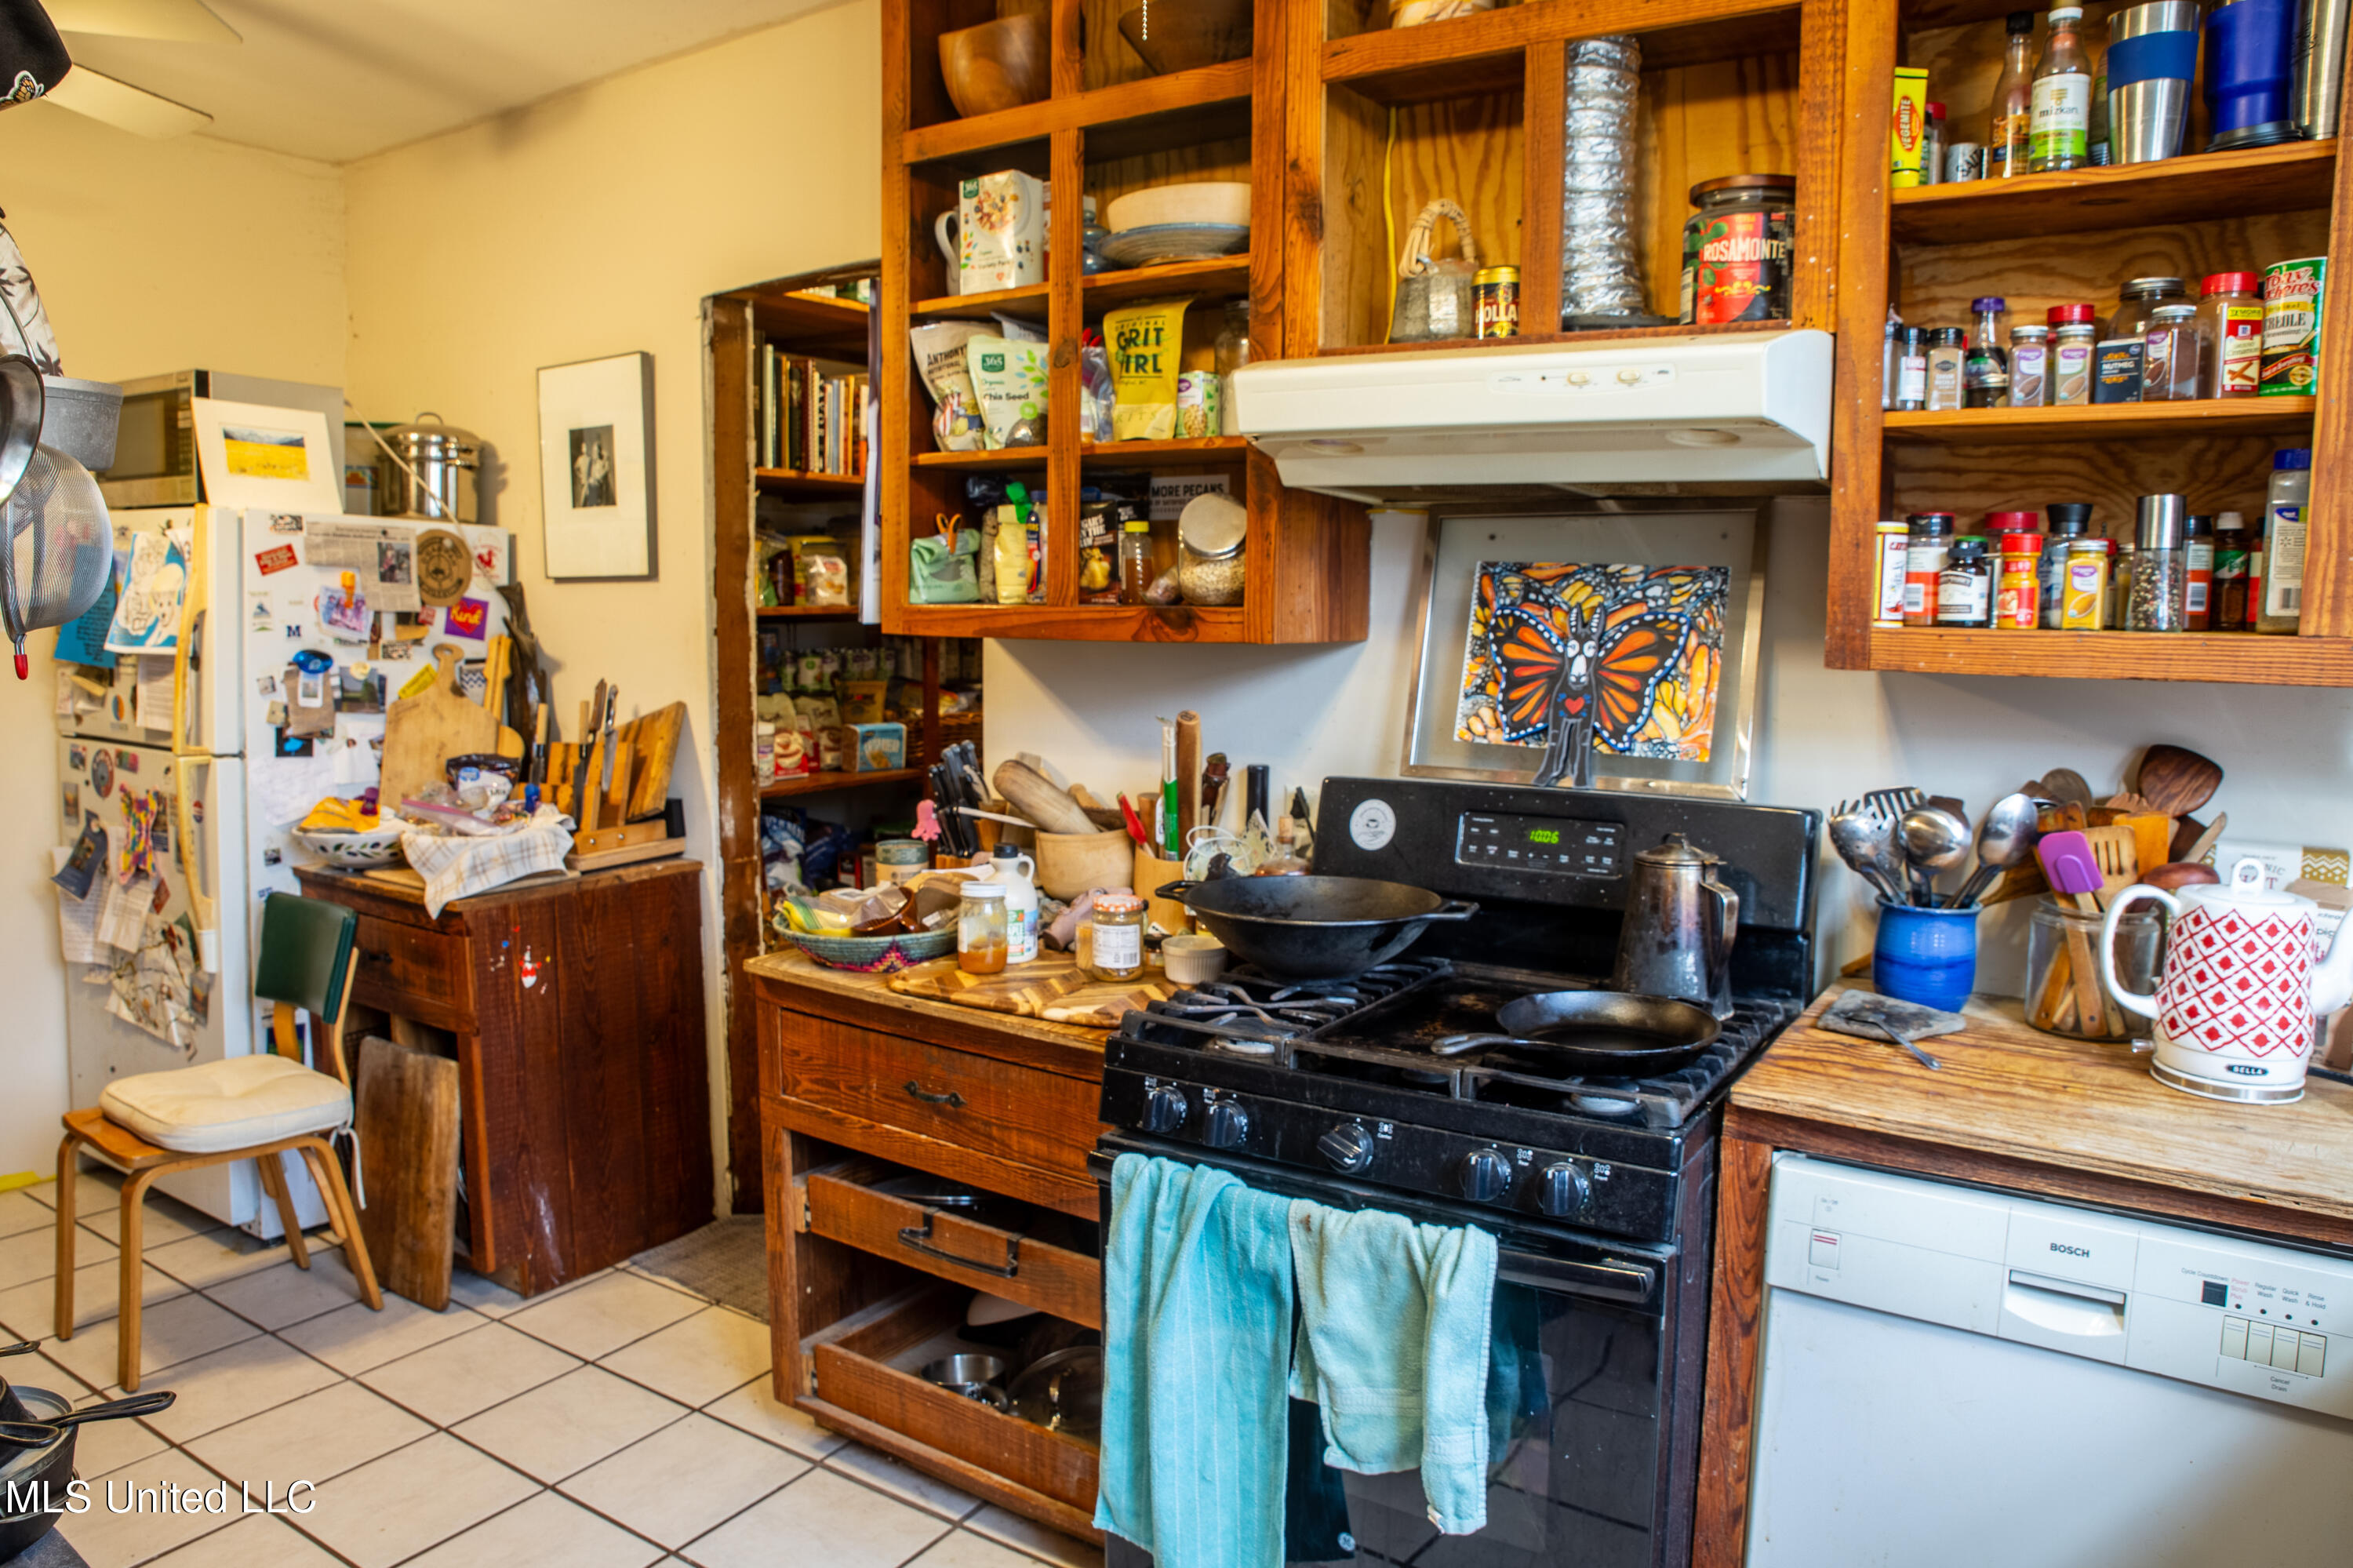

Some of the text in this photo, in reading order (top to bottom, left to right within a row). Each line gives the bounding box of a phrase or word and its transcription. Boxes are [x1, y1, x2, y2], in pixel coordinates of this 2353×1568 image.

[2039, 106, 2078, 118] mizkan
[1900, 99, 1911, 149] VEGEMITE
[1704, 238, 1786, 261] ROSAMONTE
[1116, 327, 1165, 351] GRIT
[984, 355, 1003, 366] 365
[2102, 360, 2135, 370] NUTMEG
[983, 391, 1029, 401] Chia Seed
[1151, 482, 1224, 497] MORE PECANS
[451, 605, 482, 625] Kind
[287, 625, 301, 637] M
[2232, 1066, 2264, 1075] BELLA
[2049, 1242, 2089, 1258] BOSCH
[2181, 1268, 2228, 1282] Cycle Countdown
[2255, 1282, 2277, 1292] Regular
[2257, 1290, 2274, 1299] Wash
[2282, 1288, 2299, 1297] Quick
[2308, 1293, 2326, 1301] Rinse
[2282, 1296, 2299, 1304] Wash
[2311, 1301, 2326, 1310] Hold
[2271, 1377, 2290, 1386] Cancel
[2271, 1384, 2288, 1392] Drain
